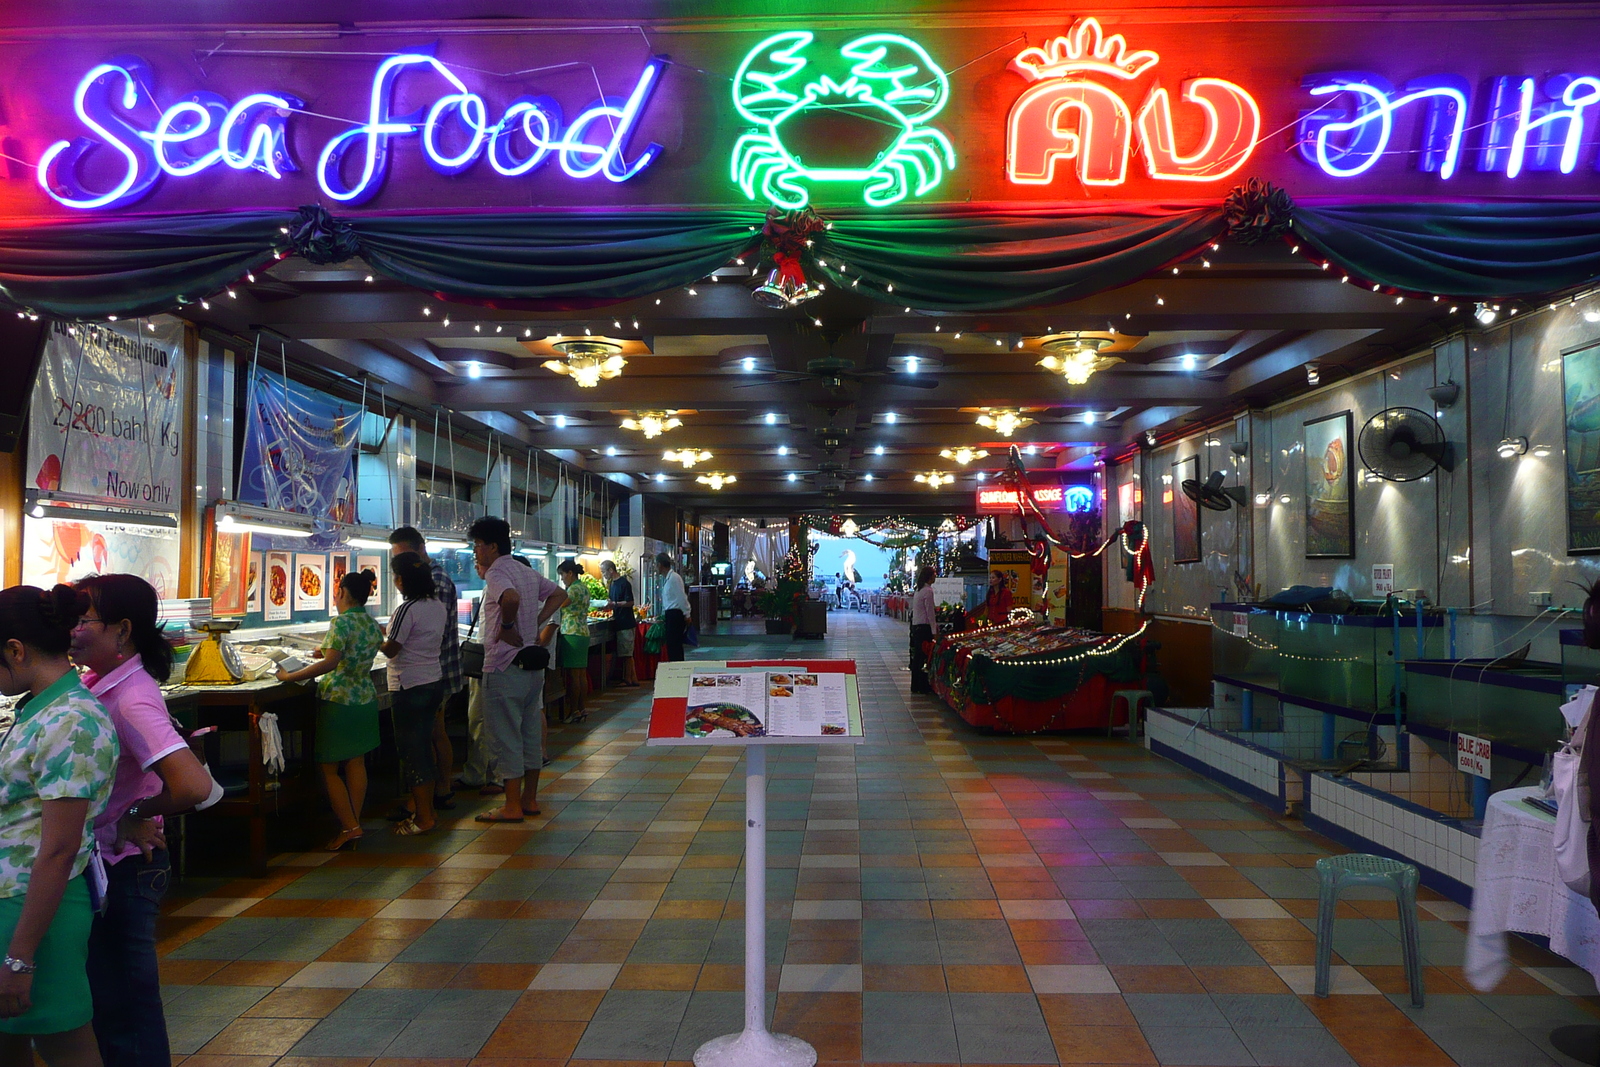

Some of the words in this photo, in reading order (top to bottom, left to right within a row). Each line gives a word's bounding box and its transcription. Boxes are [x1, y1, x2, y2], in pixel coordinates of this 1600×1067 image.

[37, 57, 304, 209] Sea
[161, 421, 179, 456] Kg
[107, 472, 140, 499] Now
[142, 481, 171, 504] only
[1458, 736, 1474, 755] BLUE
[1475, 742, 1490, 760] CRAB
